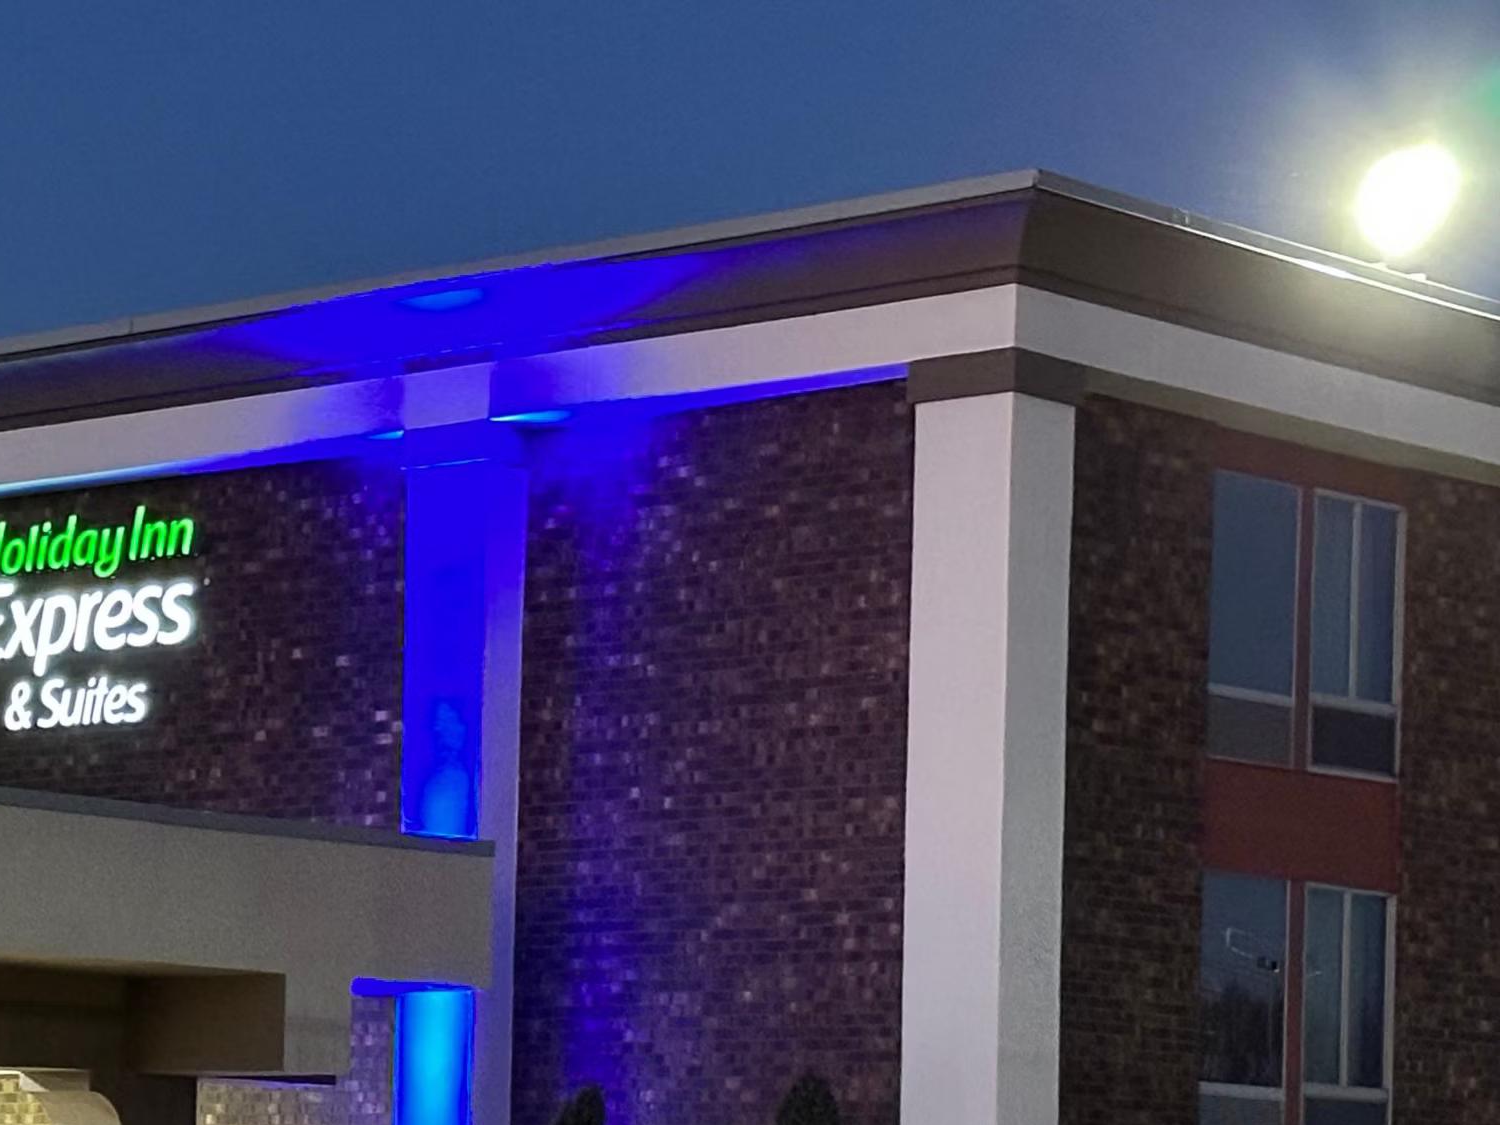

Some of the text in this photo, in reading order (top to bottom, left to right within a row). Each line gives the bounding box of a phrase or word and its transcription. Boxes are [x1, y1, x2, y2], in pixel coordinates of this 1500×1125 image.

[129, 505, 195, 561] Inn
[4, 677, 148, 731] & Suites
